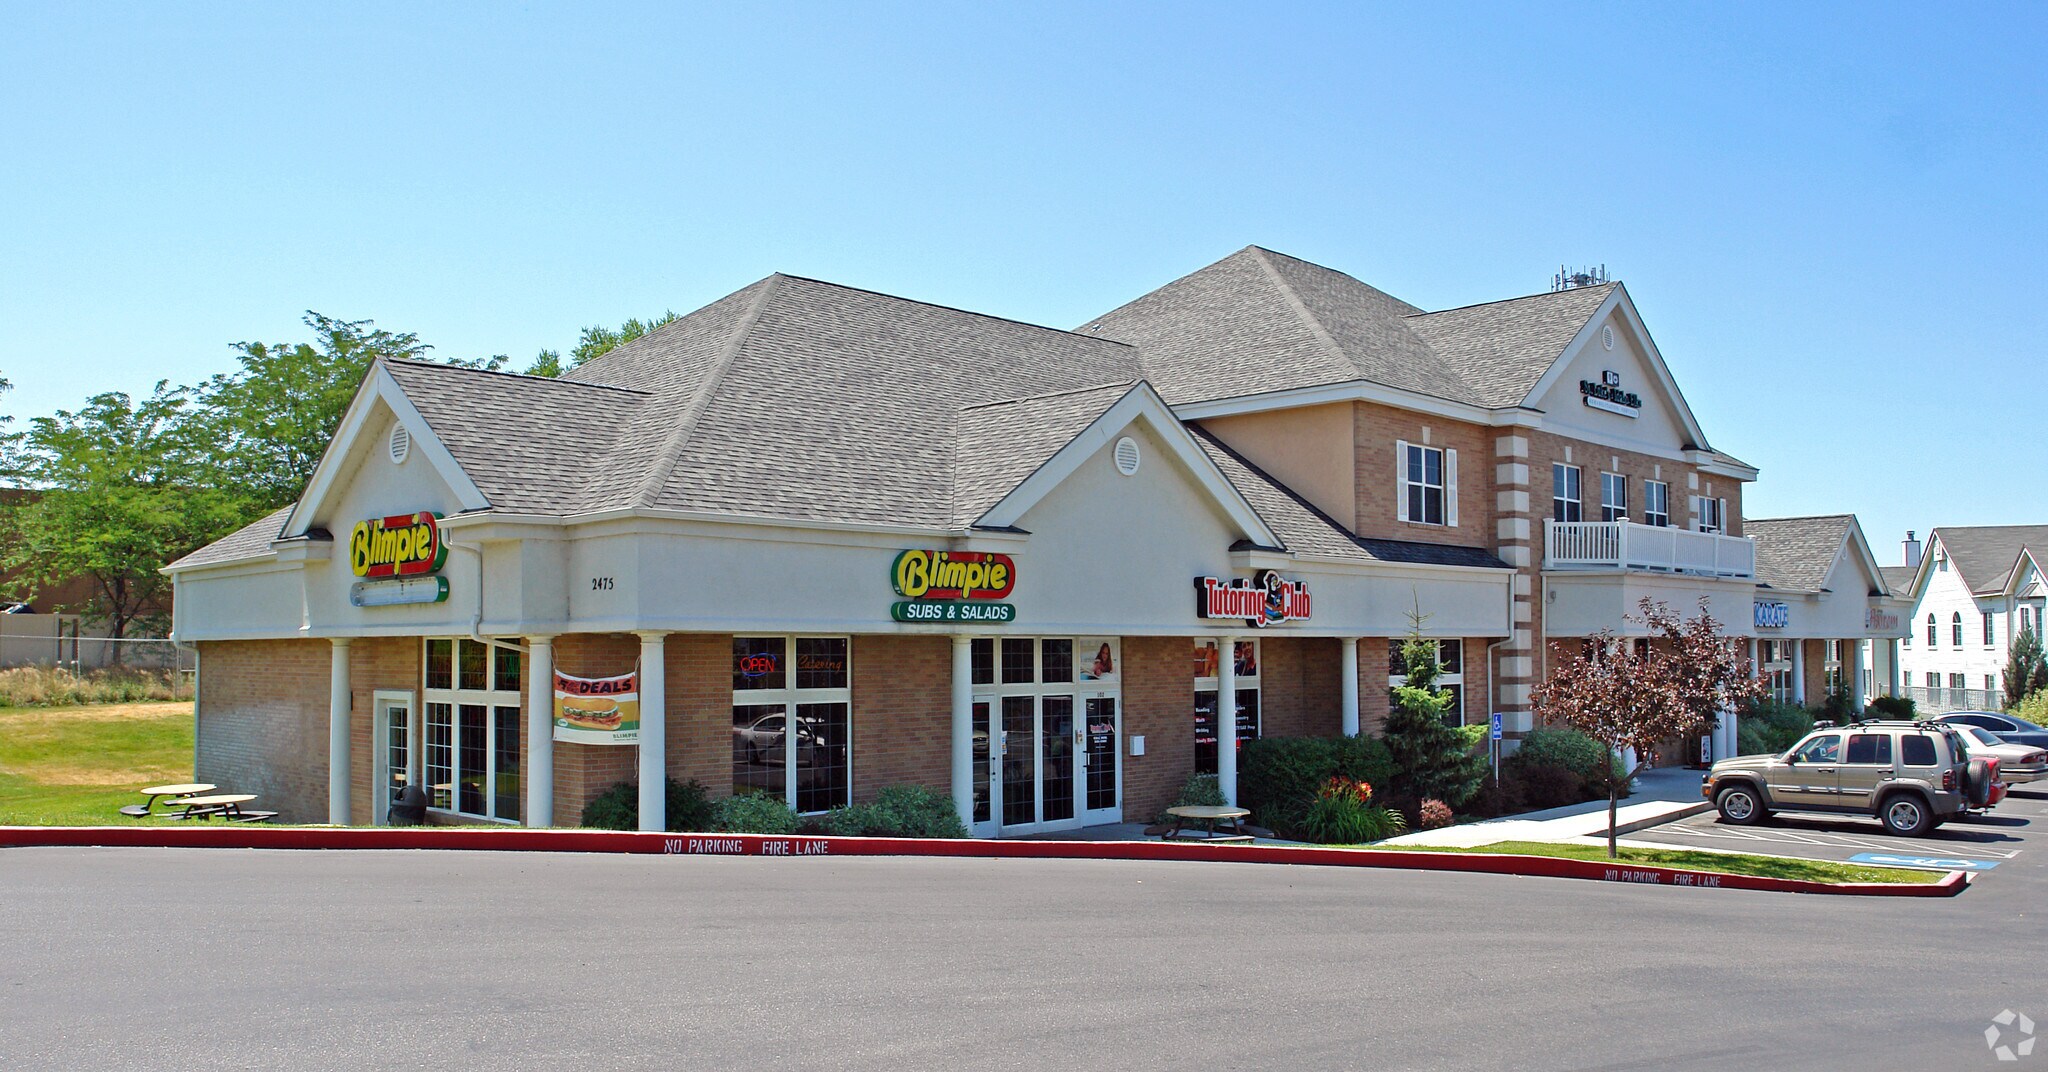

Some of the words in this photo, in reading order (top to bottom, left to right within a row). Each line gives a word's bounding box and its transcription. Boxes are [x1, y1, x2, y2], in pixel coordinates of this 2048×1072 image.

[350, 514, 430, 577] Blimpie
[898, 549, 1007, 599] Blimpie
[592, 577, 614, 591] 2475
[1205, 578, 1266, 625] Tutoring
[1281, 581, 1311, 618] Club
[907, 604, 942, 619] SUBS
[947, 605, 956, 619] &
[961, 605, 1009, 620] SALADS
[1754, 602, 1789, 627] KARATE
[740, 656, 775, 673] OPEN
[797, 654, 843, 674] Catering
[580, 679, 632, 694] DEALS
[664, 839, 682, 854] NO
[688, 839, 743, 853] PARKING
[762, 841, 790, 855] FIRE
[795, 841, 829, 854] LANE
[1605, 869, 1618, 881] NO
[1621, 870, 1661, 884] PARKING
[1674, 873, 1694, 886] FIRE
[1697, 875, 1721, 887] LANE
